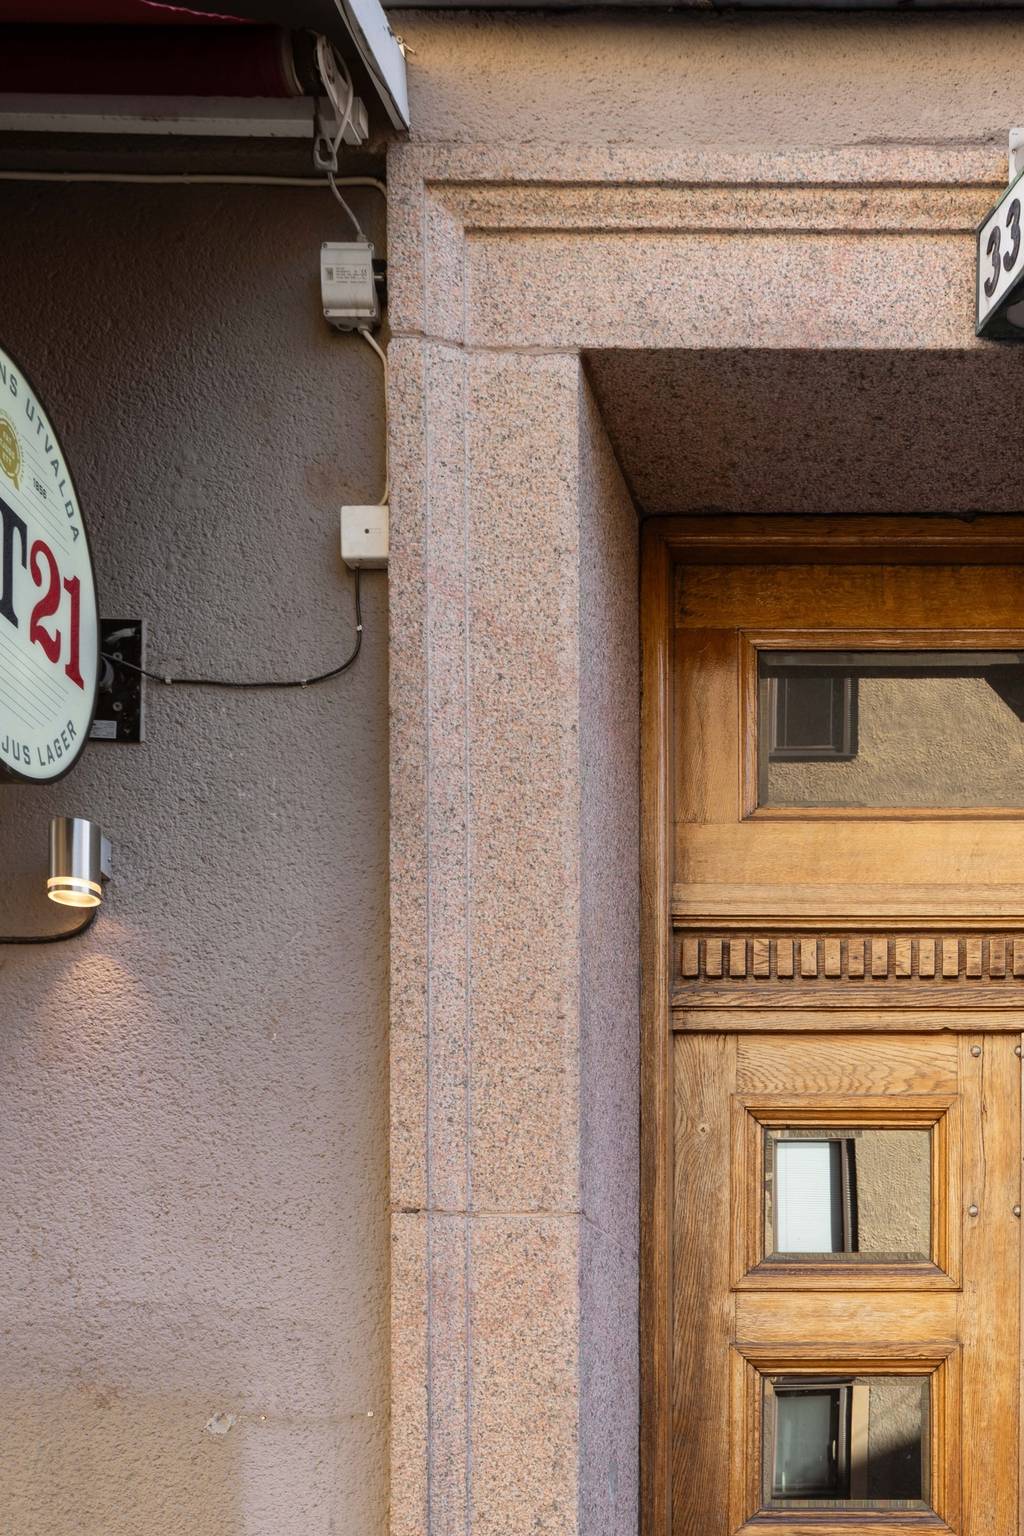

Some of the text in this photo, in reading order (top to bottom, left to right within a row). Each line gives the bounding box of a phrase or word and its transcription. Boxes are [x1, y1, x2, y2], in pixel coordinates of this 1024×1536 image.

[984, 198, 1021, 298] 33
[25, 398, 80, 542] UTVALDA
[37, 719, 77, 766] LAGER
